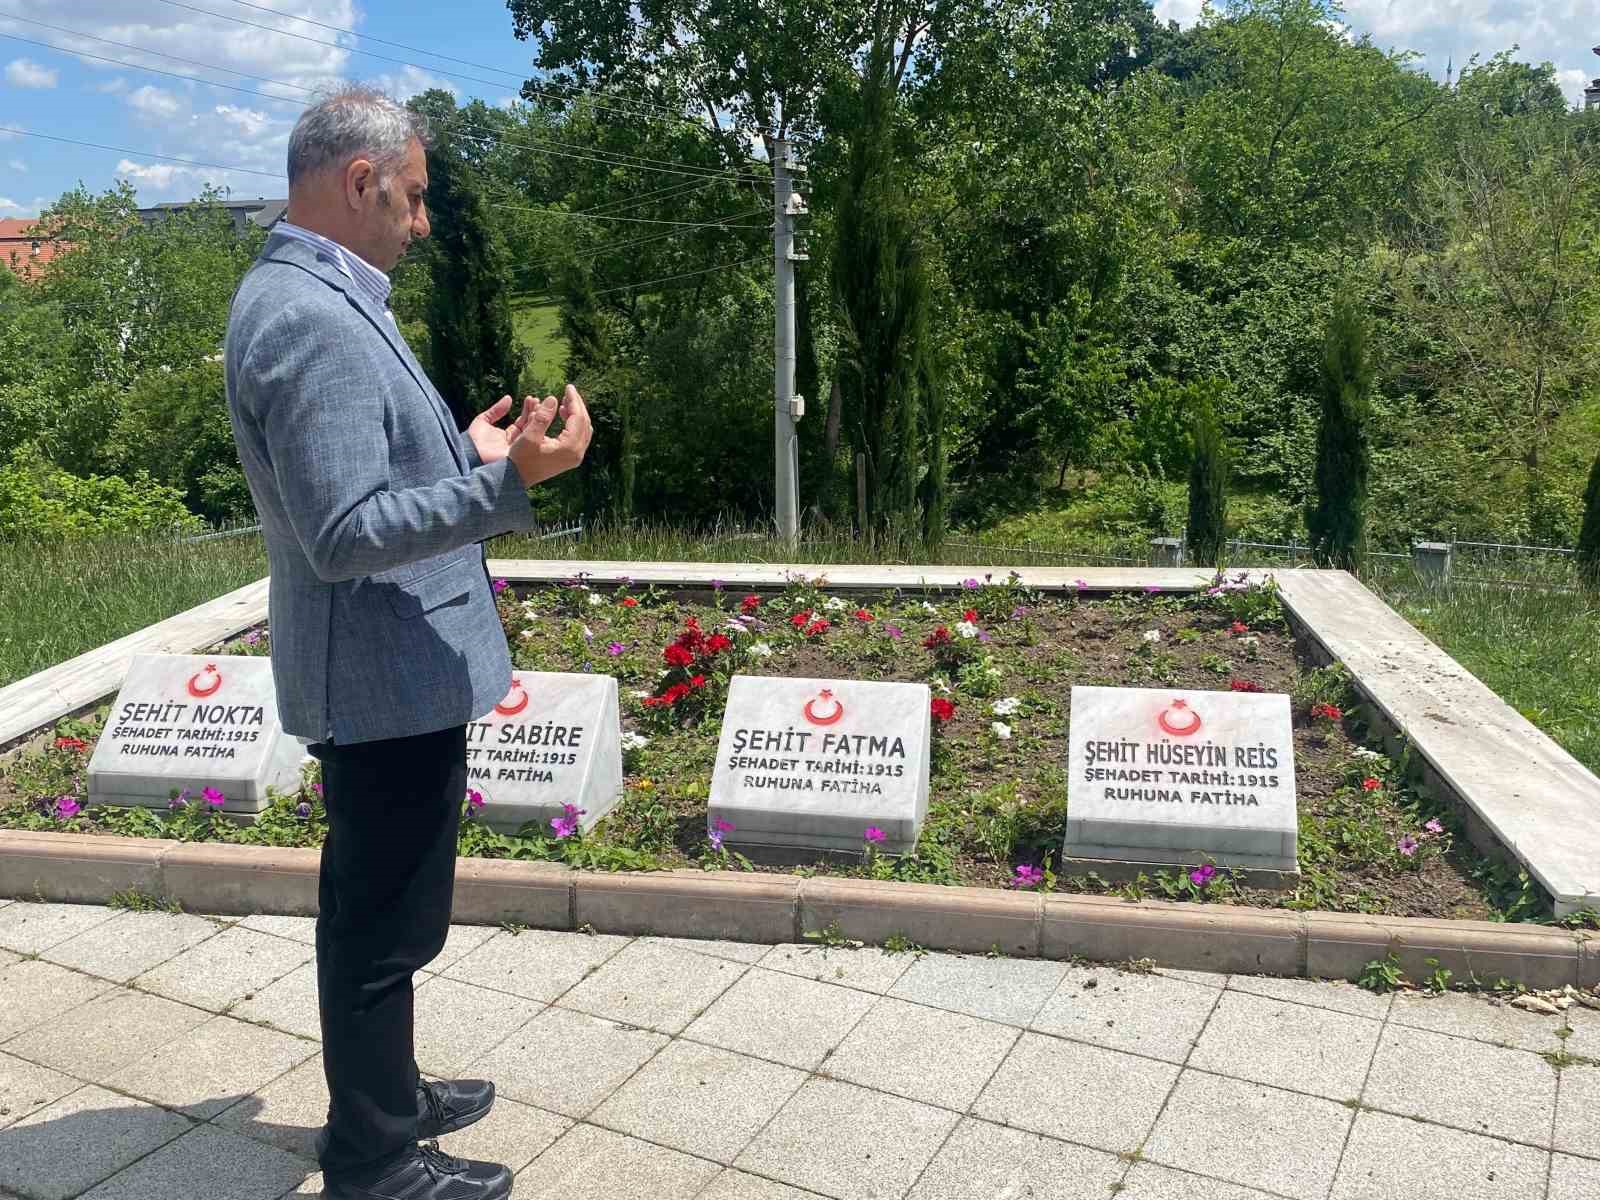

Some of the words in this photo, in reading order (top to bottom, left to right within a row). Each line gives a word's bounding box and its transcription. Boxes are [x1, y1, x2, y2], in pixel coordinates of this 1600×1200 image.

[119, 699, 188, 725] ŞEHİT
[191, 704, 264, 726] NOKTA
[111, 726, 173, 740] ŞEHADET
[498, 720, 584, 747] SABİRE
[732, 726, 812, 754] ŞEHİT
[822, 733, 906, 759] FATMA
[120, 743, 179, 757] RUHUNA
[183, 744, 236, 759] FATİHA
[1084, 737, 1140, 766] ŞEHİT
[1146, 738, 1227, 768] HÜSEYİN
[1234, 742, 1279, 769] REİS
[728, 756, 800, 771] ŞEHADET
[497, 767, 554, 783] FATİHA
[743, 775, 814, 791] RUHUNA
[820, 778, 883, 795] FATİHA
[1083, 767, 1163, 783] ŞEHADET
[1103, 787, 1183, 803] RUHUNA
[1190, 789, 1260, 807] FATİHA
